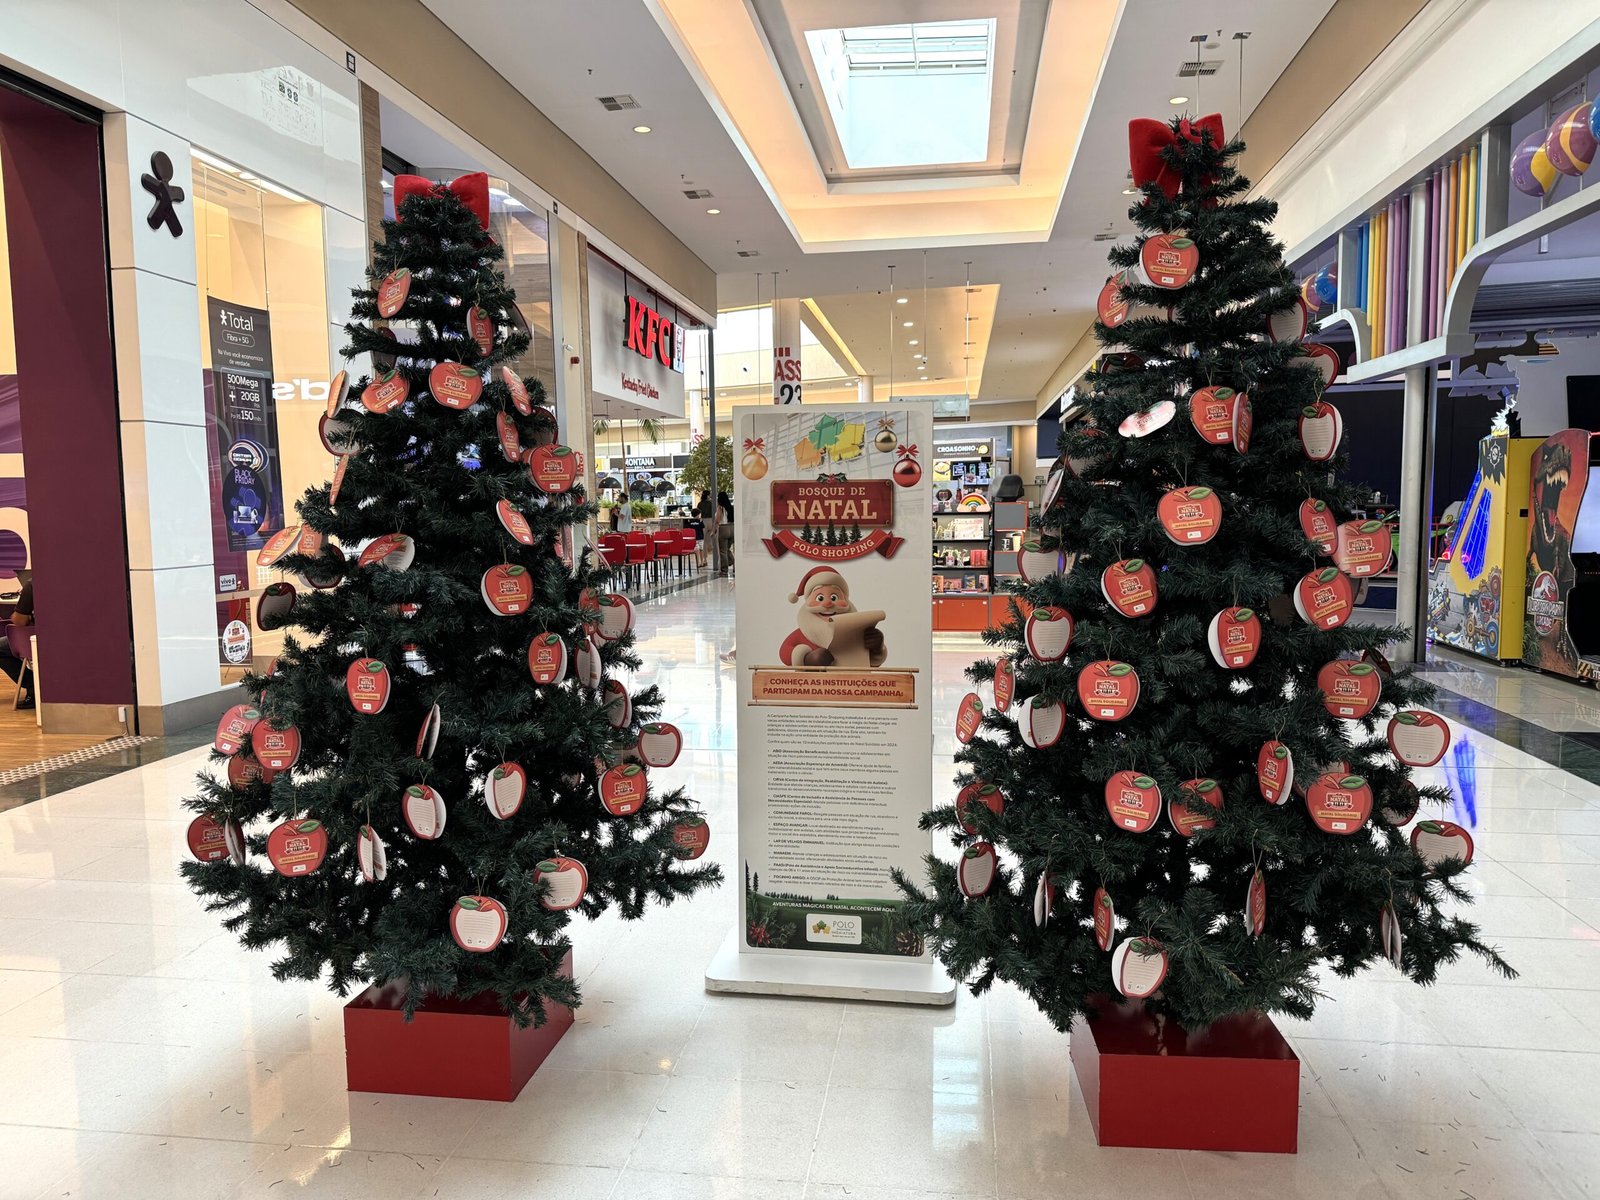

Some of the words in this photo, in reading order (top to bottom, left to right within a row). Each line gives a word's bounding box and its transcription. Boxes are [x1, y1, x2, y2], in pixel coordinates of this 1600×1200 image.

[227, 312, 254, 331] Total
[628, 296, 670, 368] KFC
[227, 334, 238, 342] Fibra
[242, 336, 250, 344] 5G
[228, 374, 258, 388] 500Mega
[241, 391, 260, 402] 20GB
[241, 410, 254, 420] 150
[235, 468, 252, 477] BLACK
[235, 476, 255, 485] FRIDAY
[799, 488, 845, 497] BOSQUE
[787, 500, 877, 520] NATAL
[793, 540, 819, 556] POLO
[822, 540, 874, 557] SHOPPING
[770, 678, 808, 686] CONHEÇA
[823, 678, 877, 688] INSTITUIÇÕES
